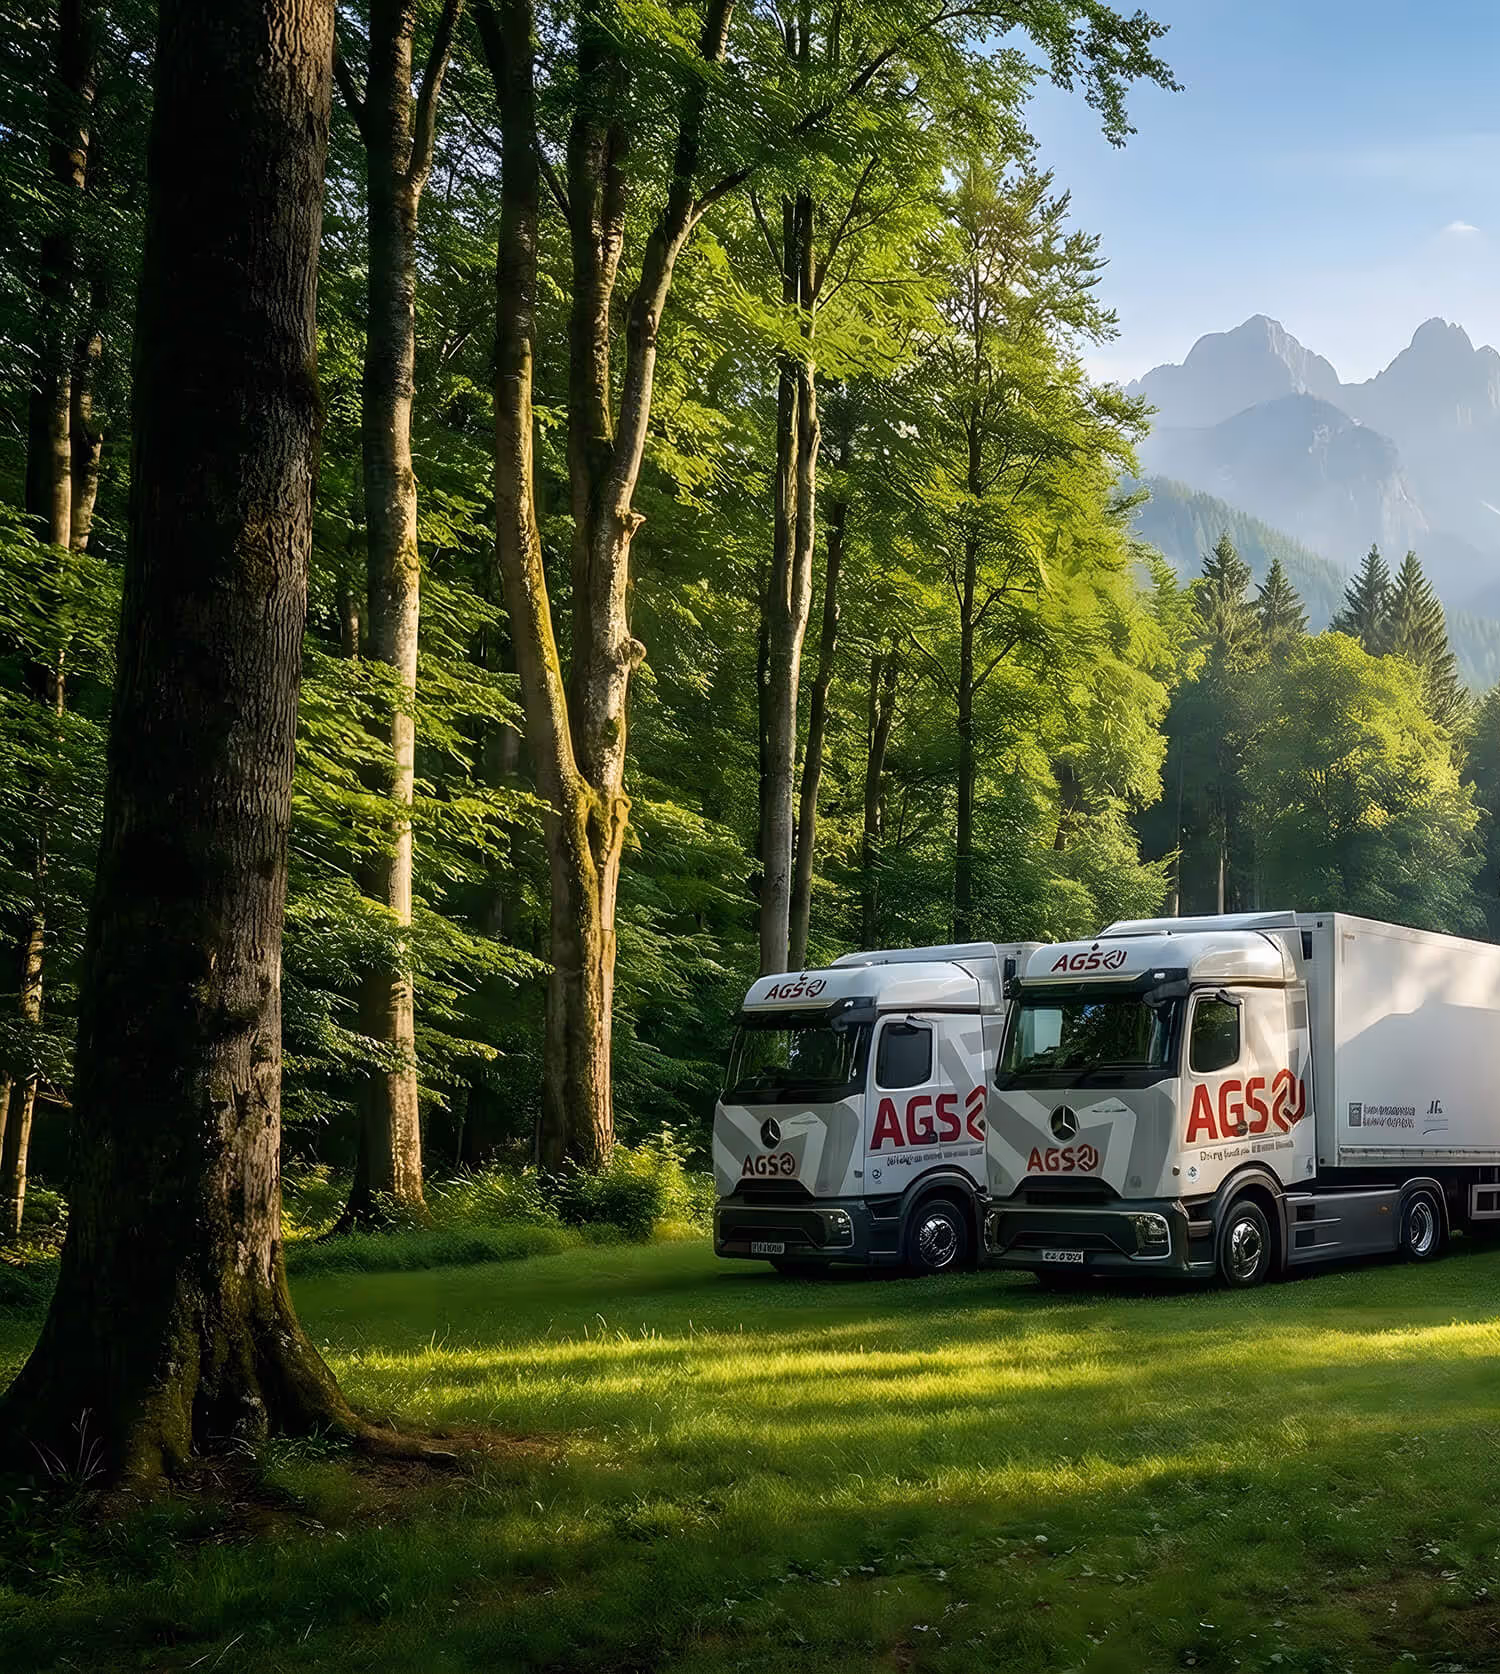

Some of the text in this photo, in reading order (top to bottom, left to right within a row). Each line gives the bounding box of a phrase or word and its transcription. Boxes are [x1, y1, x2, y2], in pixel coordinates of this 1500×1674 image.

[1052, 954, 1101, 972] AGS
[763, 984, 803, 1001] AGS
[1186, 1078, 1268, 1143] AGS
[869, 1094, 961, 1150] AGS
[742, 1155, 778, 1176] AGS
[1027, 1148, 1076, 1172] AGS
